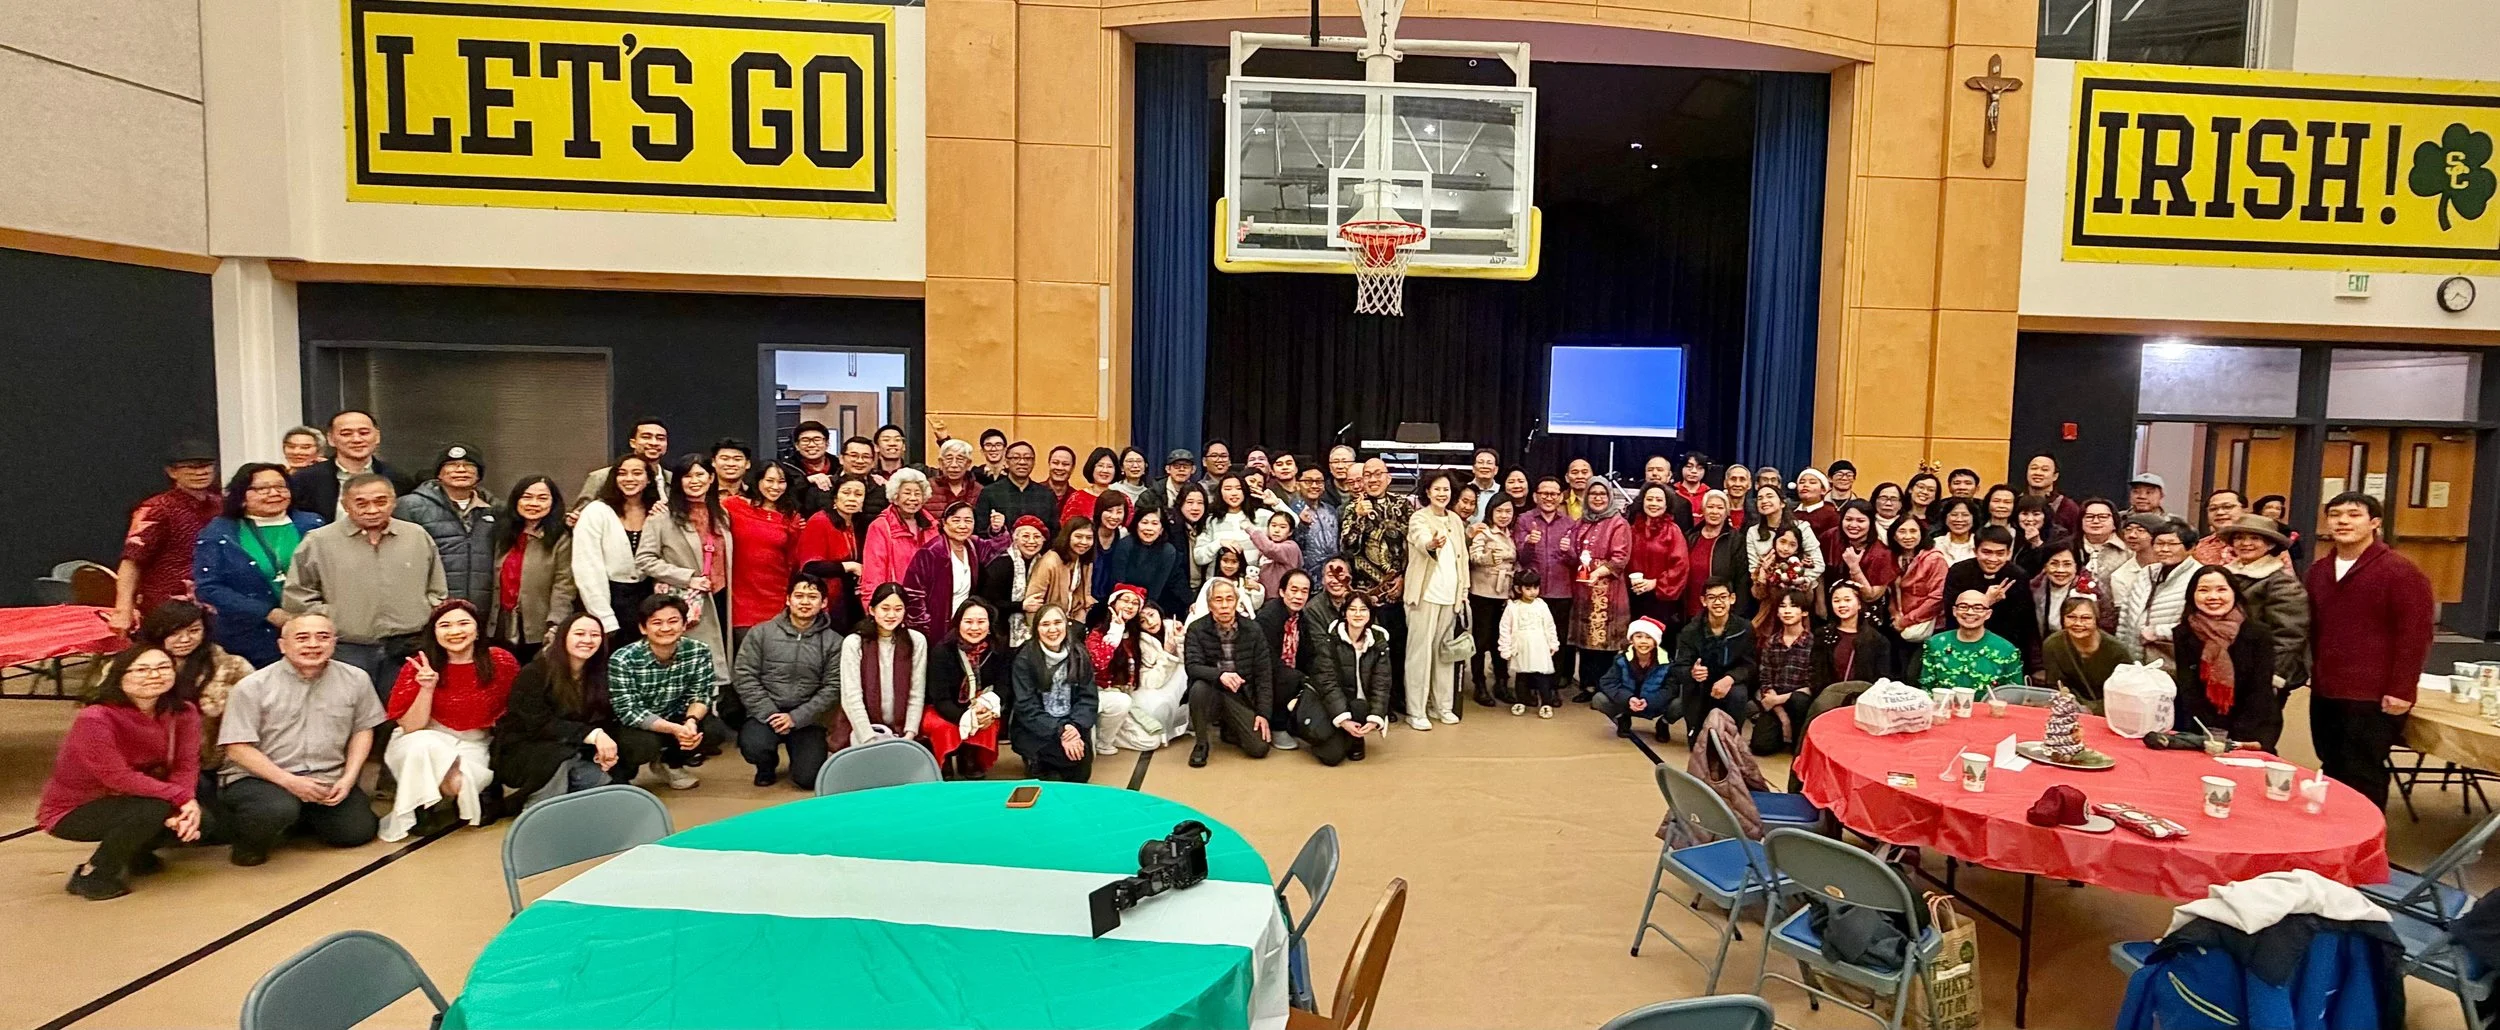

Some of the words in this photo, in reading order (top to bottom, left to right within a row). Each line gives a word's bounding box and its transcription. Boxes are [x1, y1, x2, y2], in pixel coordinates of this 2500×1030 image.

[376, 33, 694, 162] LET'S
[731, 52, 864, 168] GO
[2092, 111, 2402, 225] IRISH!
[2348, 274, 2370, 292] EXIT
